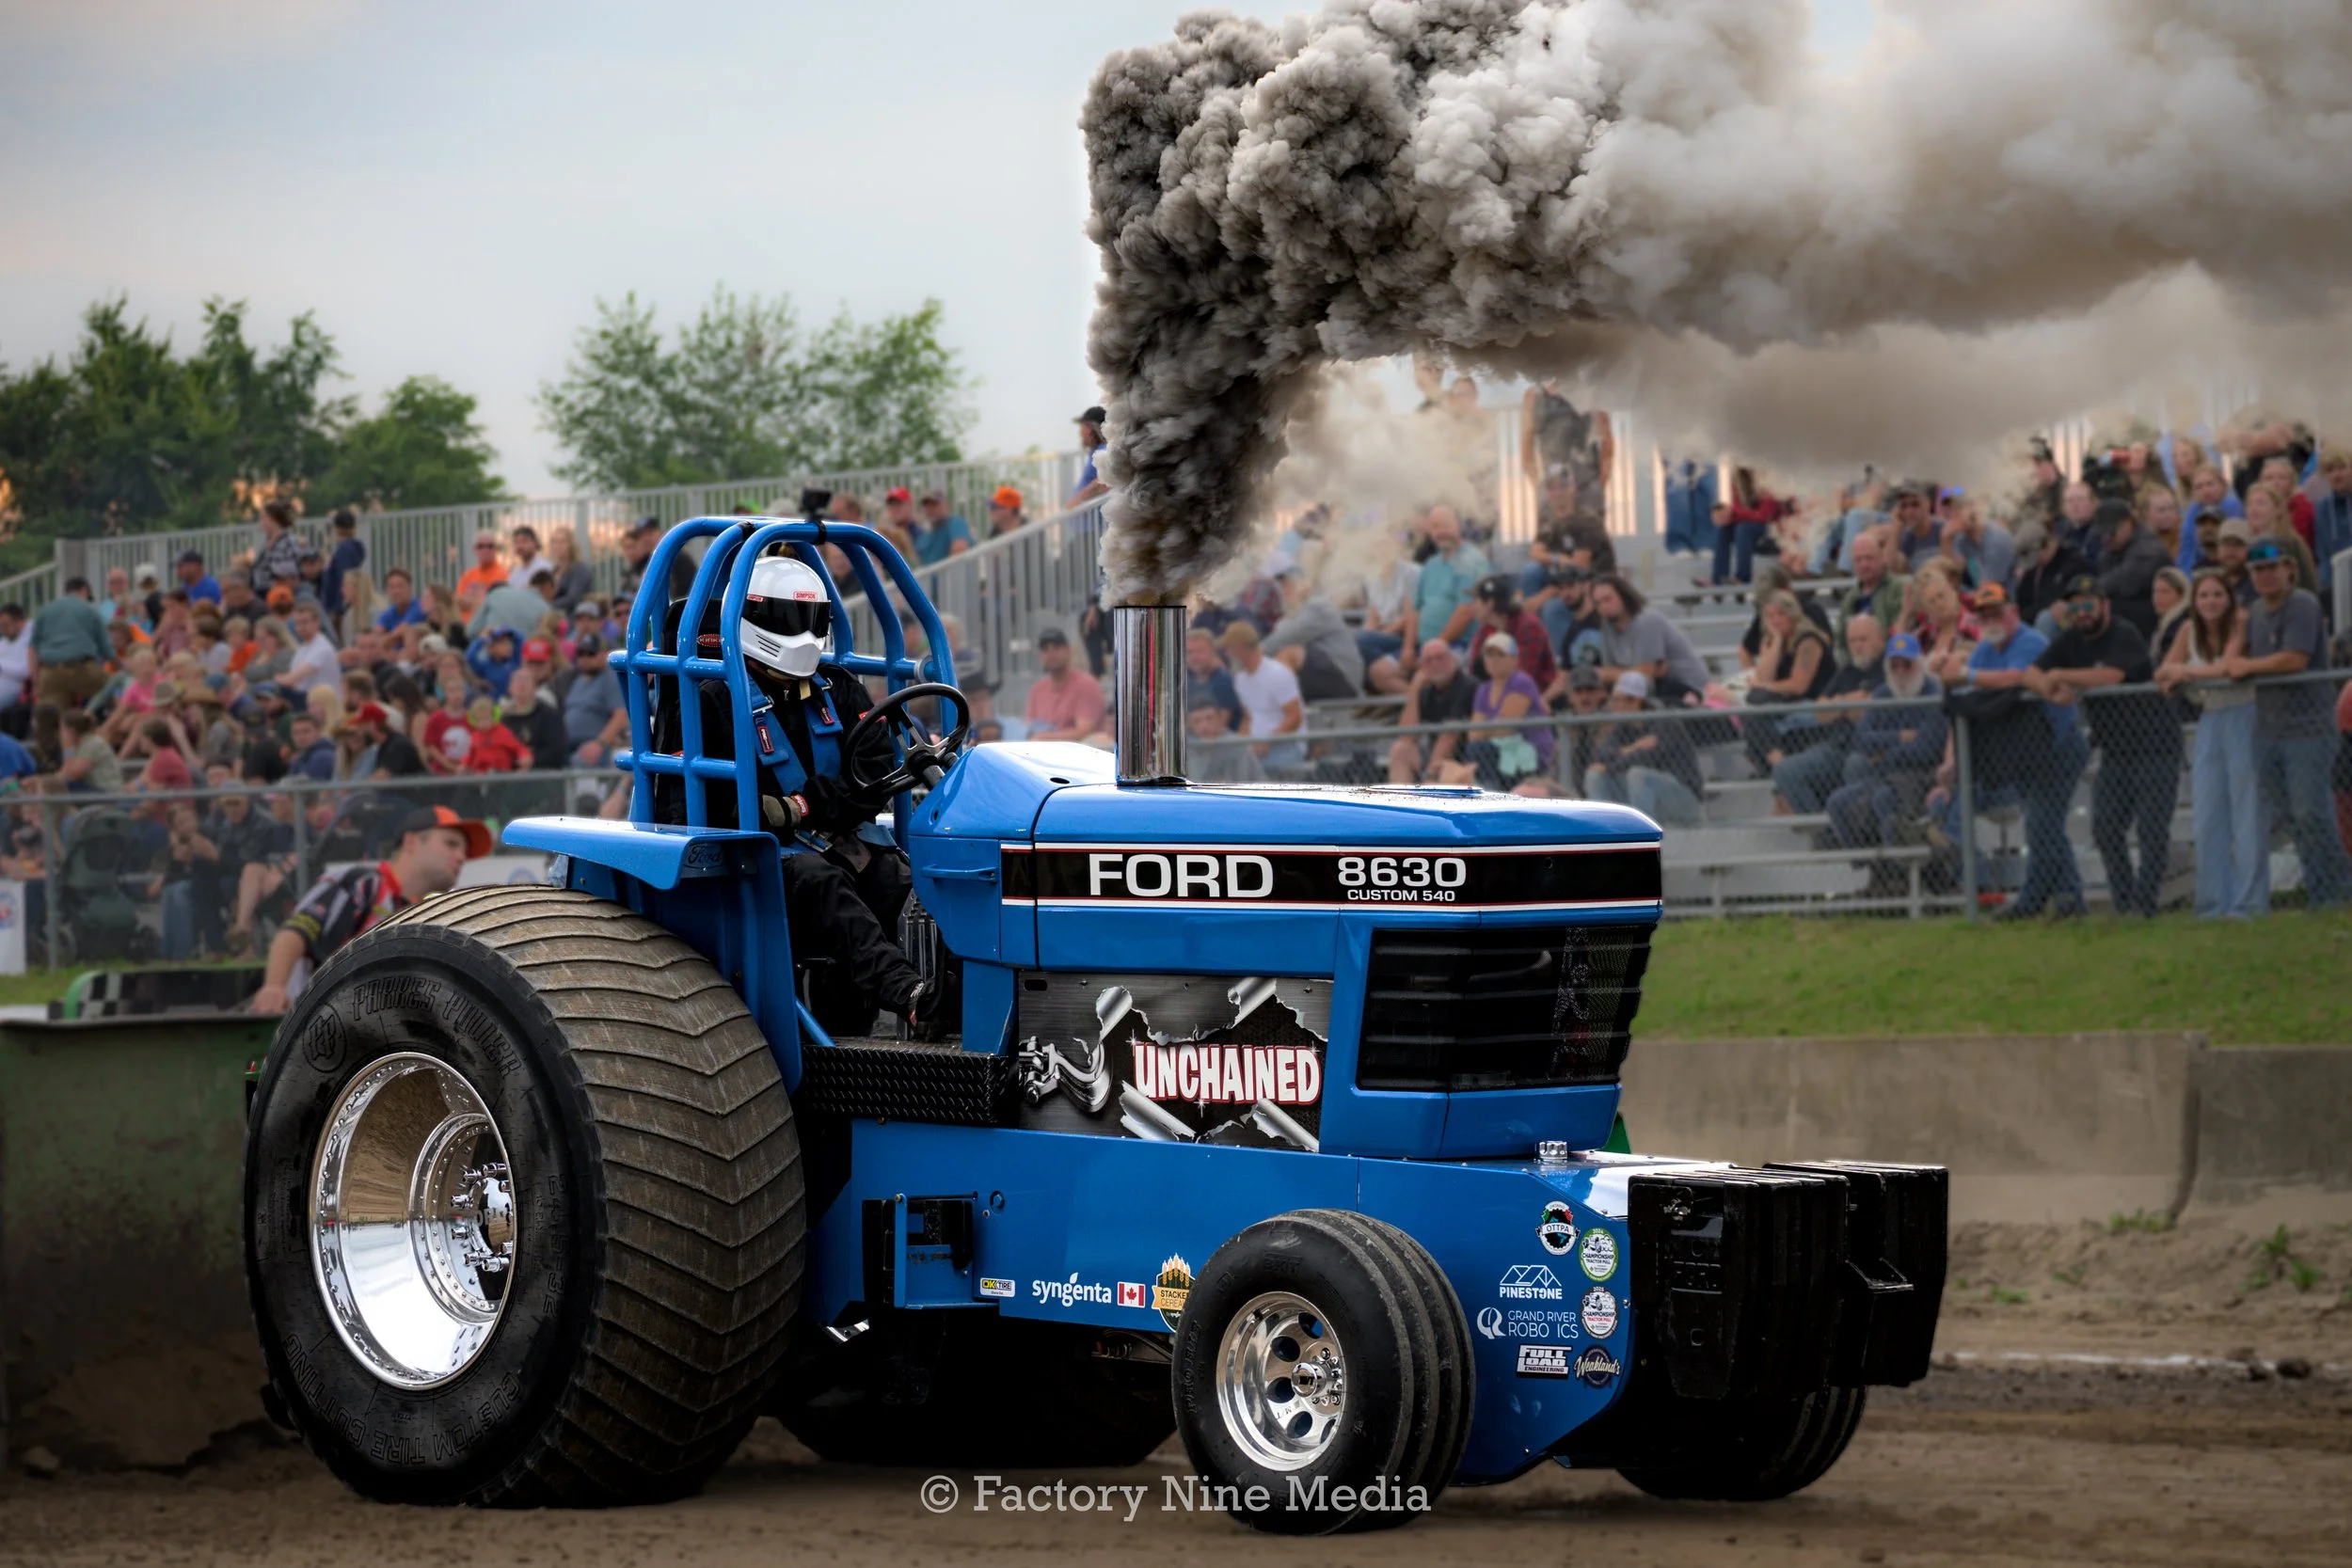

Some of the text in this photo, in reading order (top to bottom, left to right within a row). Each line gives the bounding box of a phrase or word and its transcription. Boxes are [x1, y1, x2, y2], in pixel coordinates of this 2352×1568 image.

[688, 846, 723, 863] Ford
[1089, 853, 1274, 898] FORD
[1338, 856, 1468, 888] 8630
[1347, 888, 1456, 902] CUSTOM 540
[1134, 1042, 1322, 1105] UNCHAINED
[1546, 1225, 1570, 1233] OTTPA
[982, 1279, 996, 1290] OK
[1032, 1279, 1112, 1307] syngenta
[1500, 1287, 1563, 1299] PINESTONE
[1160, 1298, 1184, 1307] CEREA
[1507, 1310, 1577, 1323] GRAND RIVER
[1519, 1345, 1572, 1359] FULL
[1517, 1357, 1566, 1370] LOAD
[1573, 1355, 1621, 1378] Weakland's
[286, 1333, 521, 1465] CUSTOM TIRE CUTTING
